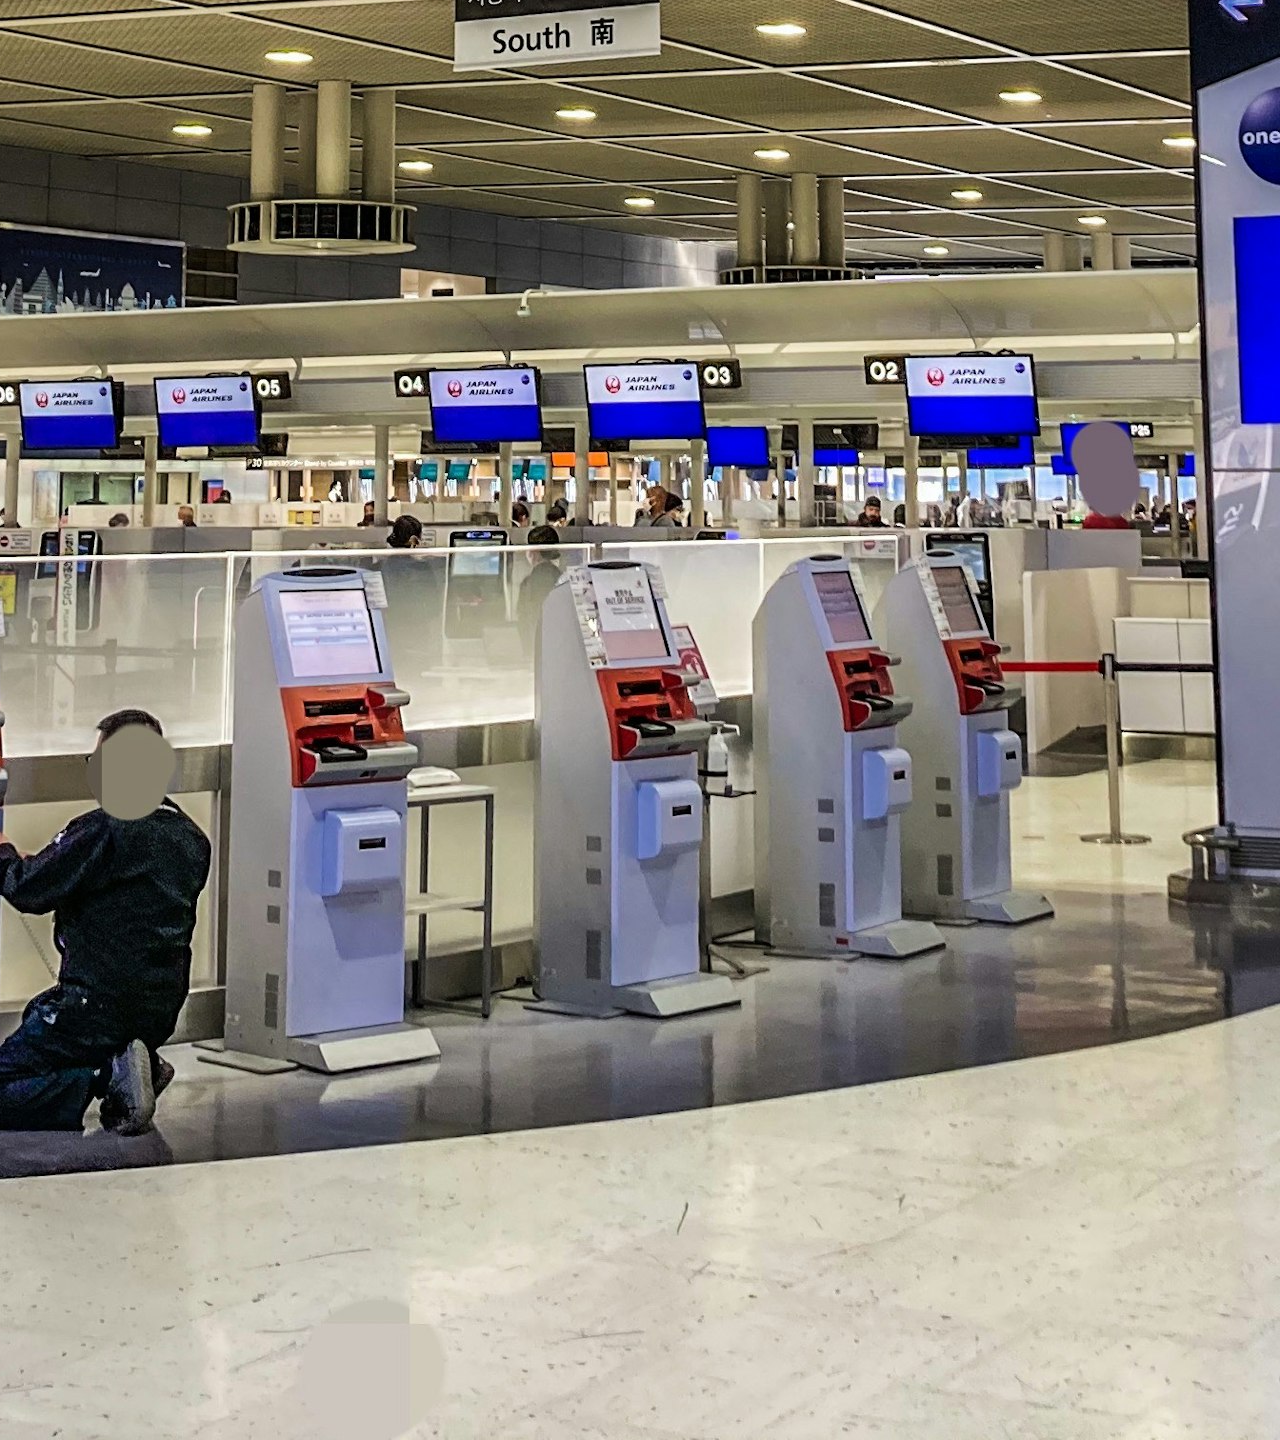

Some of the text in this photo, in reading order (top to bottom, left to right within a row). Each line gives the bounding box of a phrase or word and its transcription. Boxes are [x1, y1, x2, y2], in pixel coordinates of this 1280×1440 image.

[492, 17, 615, 55] South 南
[703, 365, 731, 383] 03
[869, 361, 899, 381] 02
[949, 368, 986, 376] JAPAN
[256, 379, 280, 396] 05
[398, 375, 424, 392] 04
[466, 380, 497, 388] JAPAN
[952, 377, 1006, 385] AIRLINES
[468, 388, 514, 396] AIRLINES
